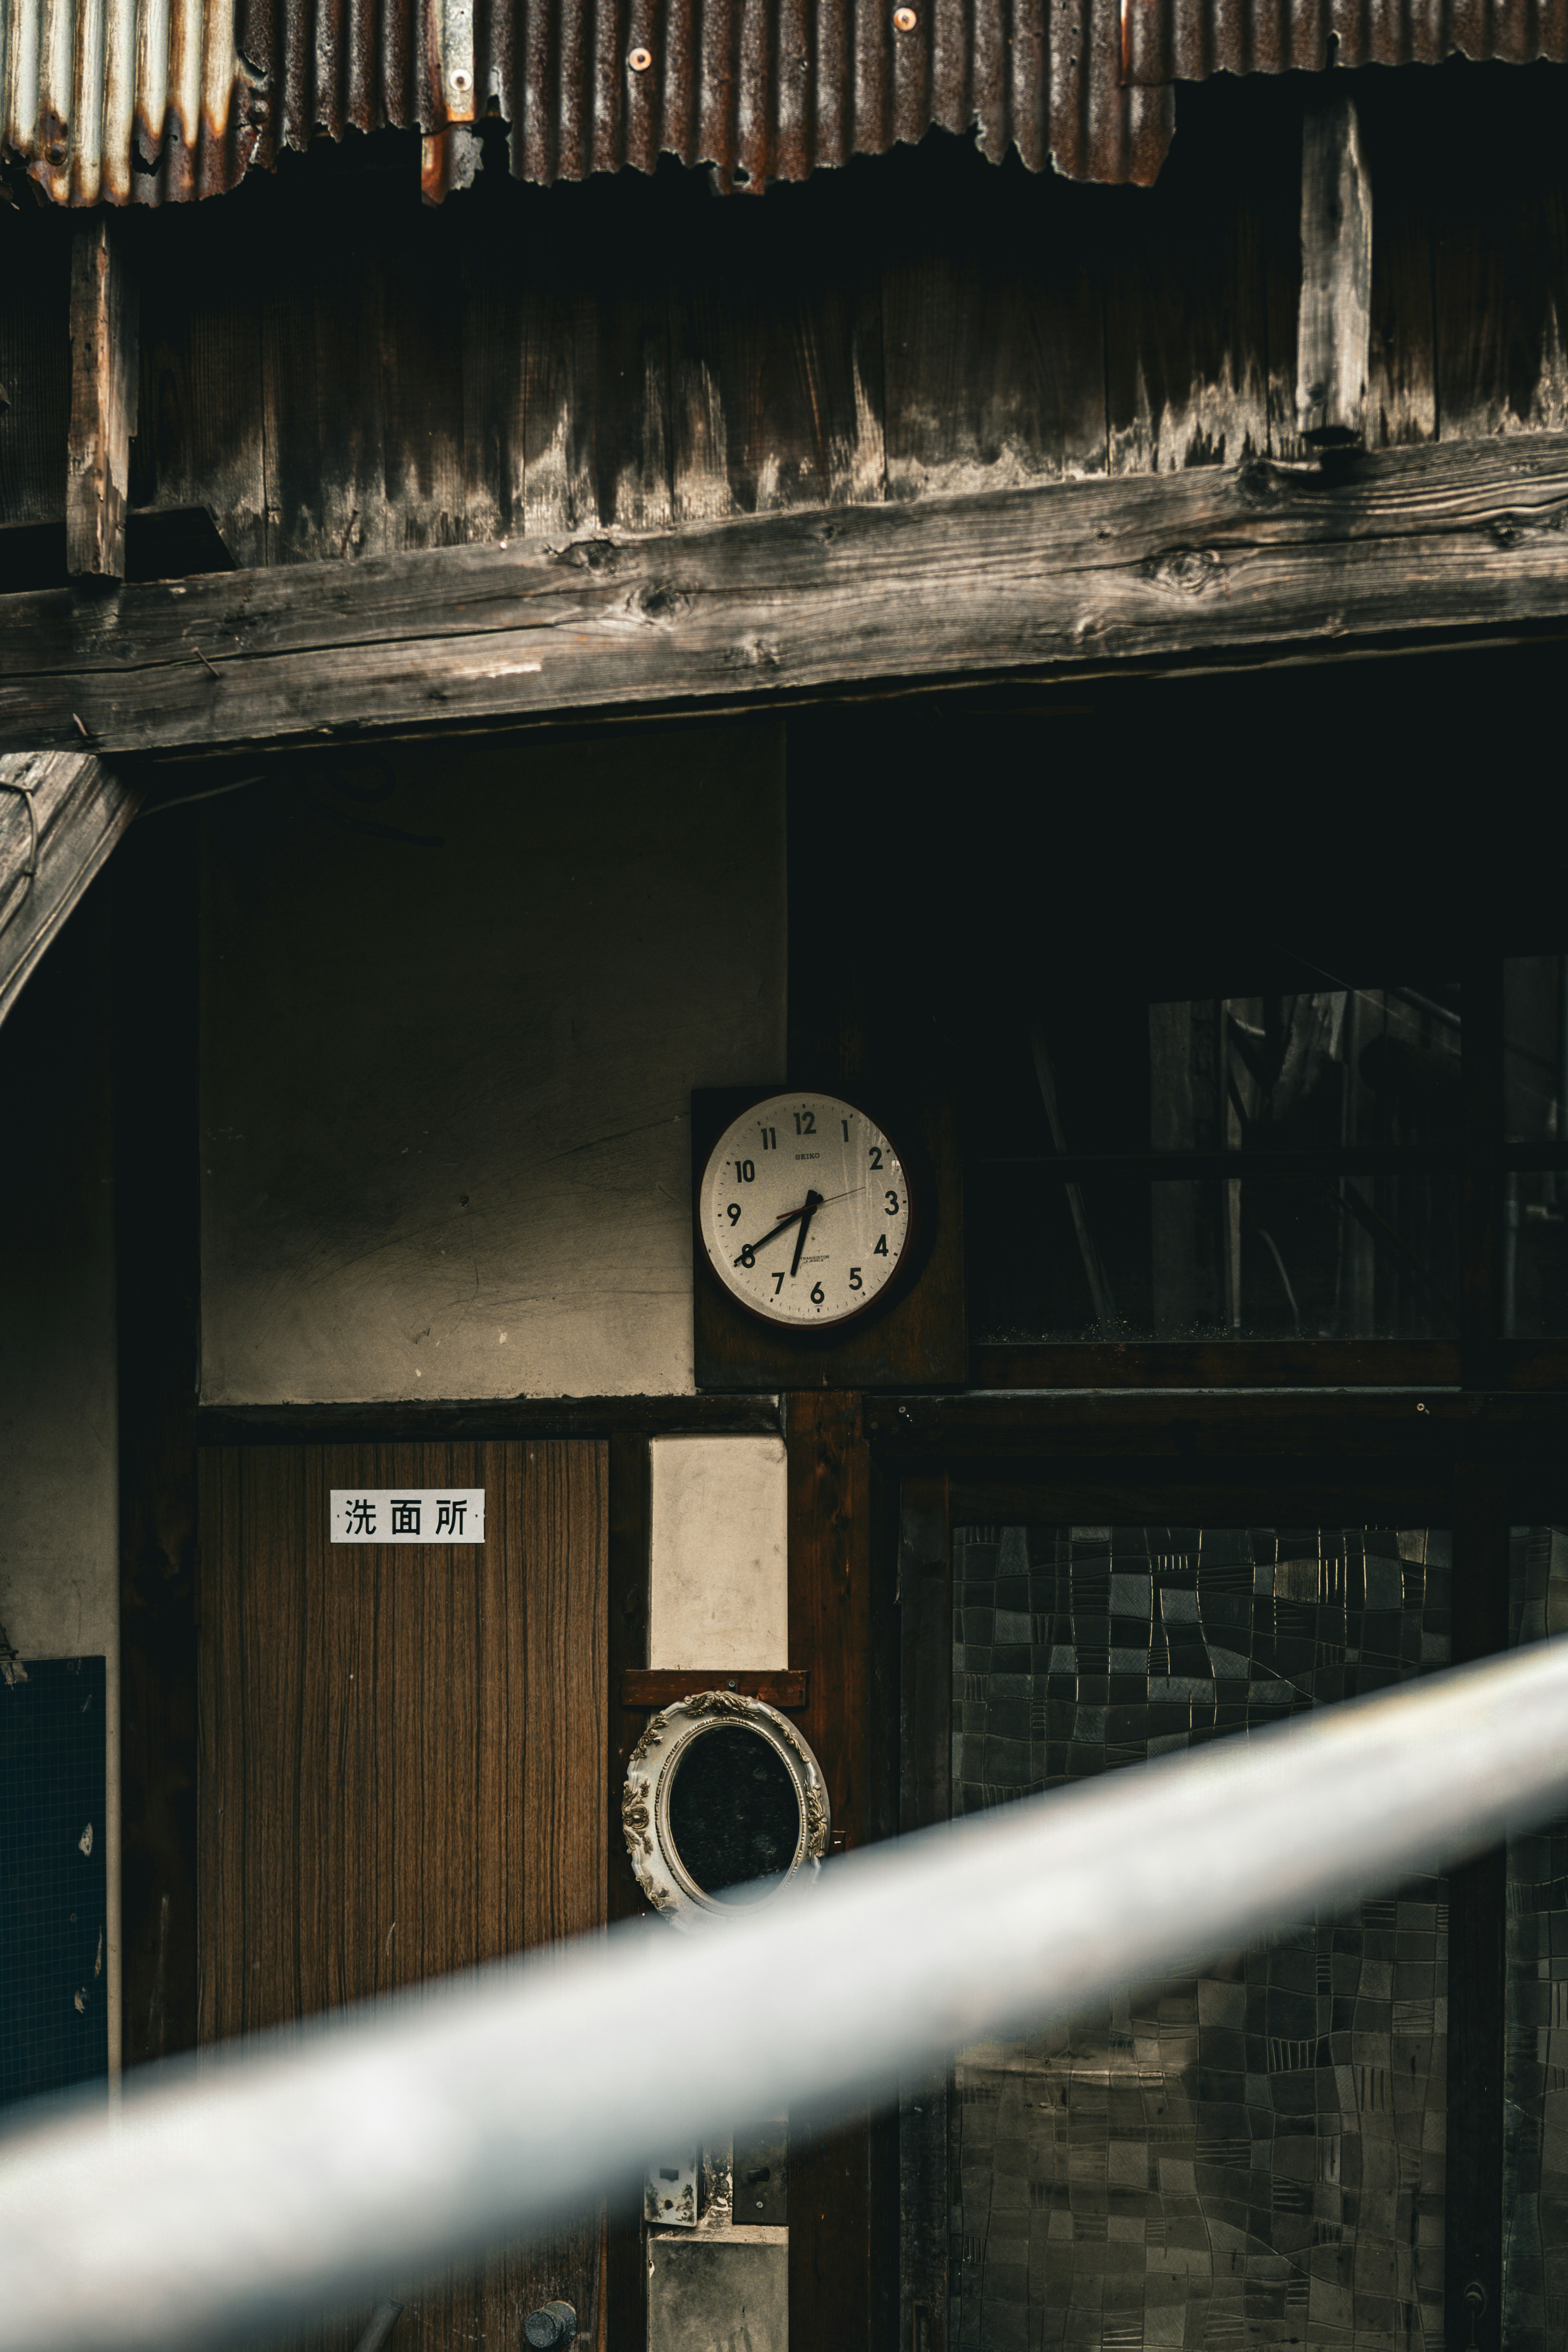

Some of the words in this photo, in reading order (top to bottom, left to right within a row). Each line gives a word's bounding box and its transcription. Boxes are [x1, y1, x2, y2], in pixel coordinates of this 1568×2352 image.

[793, 1111, 817, 1136] 12
[841, 1119, 849, 1143] 1
[760, 1127, 777, 1150] 11
[869, 1147, 884, 1170] 2
[735, 1159, 755, 1183] 10
[727, 1203, 742, 1227] 9
[884, 1190, 900, 1216] 3
[742, 1243, 756, 1269] 8
[873, 1234, 889, 1257] 4
[771, 1272, 785, 1295] 7
[849, 1267, 863, 1290] 5
[810, 1281, 825, 1304] 6
[345, 1499, 467, 1535] 洗面所
